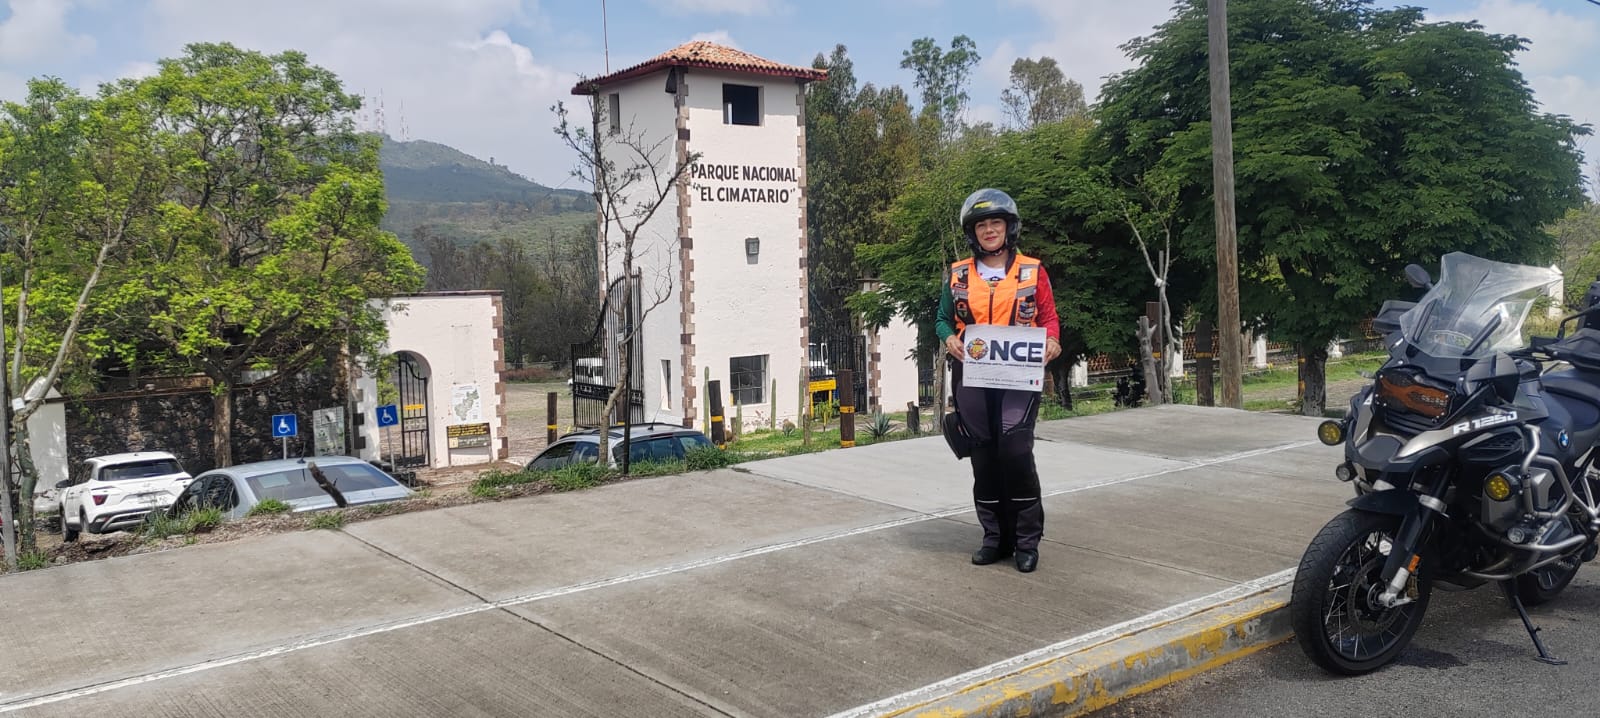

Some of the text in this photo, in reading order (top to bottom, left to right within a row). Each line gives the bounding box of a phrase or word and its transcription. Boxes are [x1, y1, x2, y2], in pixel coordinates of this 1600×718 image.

[691, 163, 797, 182] PARQUE NACIONAL
[1453, 421, 1471, 435] R
